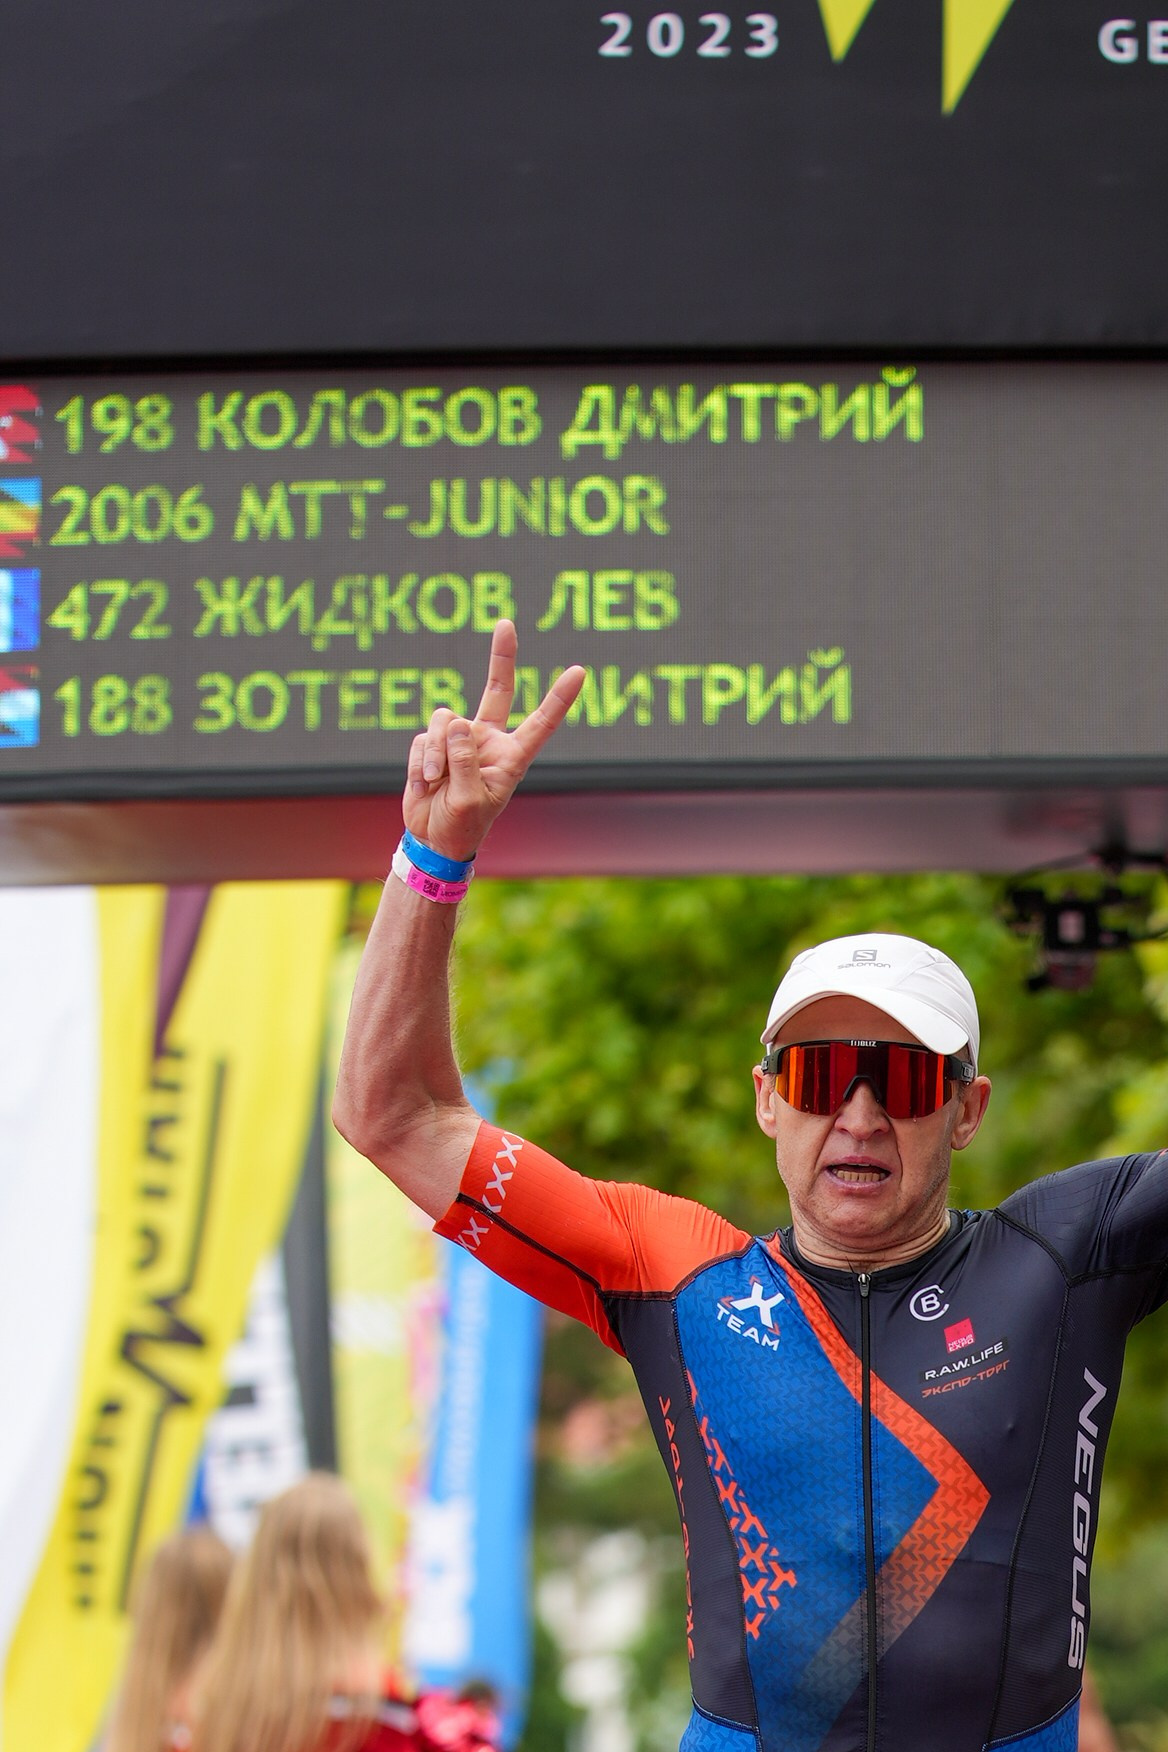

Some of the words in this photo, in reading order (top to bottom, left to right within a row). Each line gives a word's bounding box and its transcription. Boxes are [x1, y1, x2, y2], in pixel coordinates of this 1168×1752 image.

[598, 12, 779, 58] 2023
[55, 393, 174, 454] 198
[196, 387, 542, 452] КОЛОБОВ
[559, 366, 925, 460] ДМИТРИЙ
[49, 484, 214, 546] 2006
[233, 474, 671, 542] MTT-JUNIOR
[46, 579, 172, 642] 472
[193, 571, 517, 652] ЖИДКОВ
[54, 674, 174, 737] 188
[193, 667, 468, 733] ЗОТЕЕВ
[838, 961, 892, 970] salomon
[716, 1302, 780, 1352] TEAM
[1067, 1366, 1108, 1670] NEGUS
